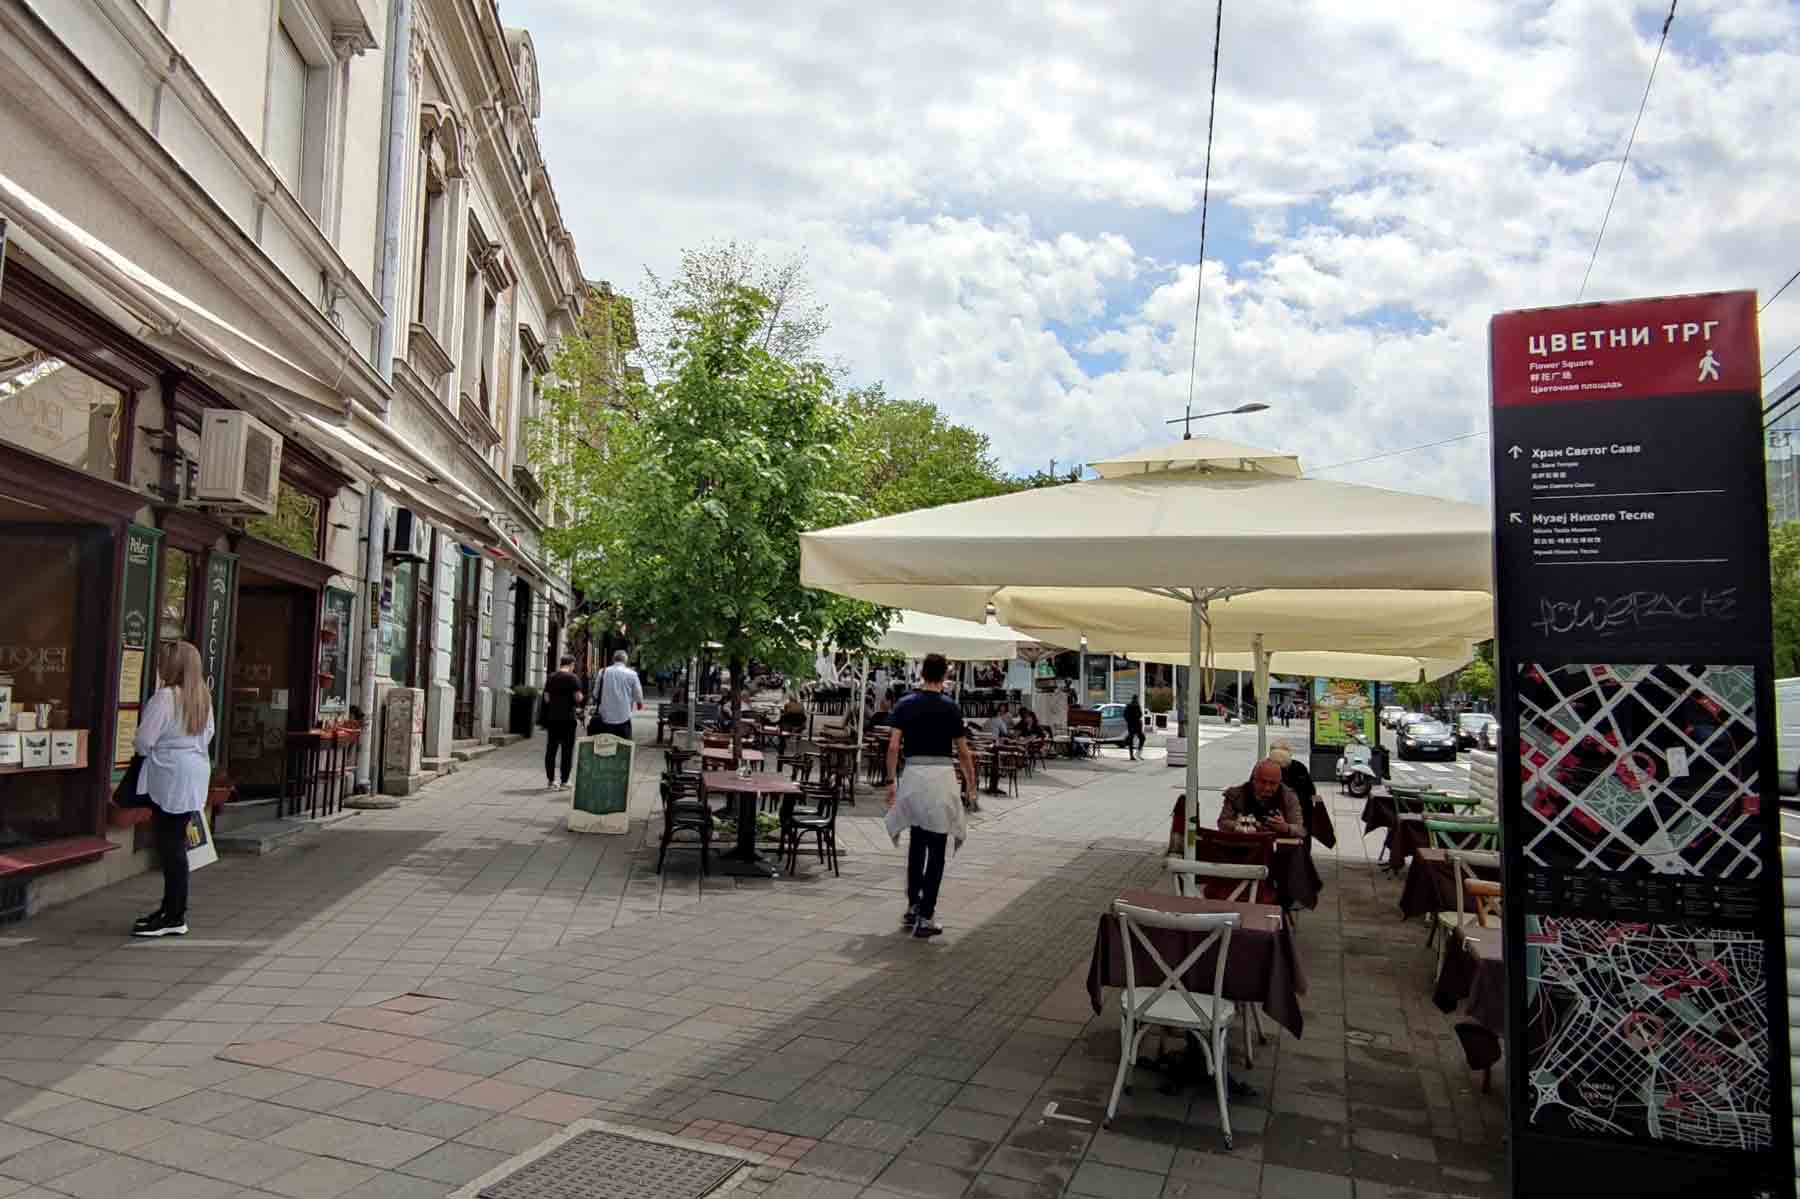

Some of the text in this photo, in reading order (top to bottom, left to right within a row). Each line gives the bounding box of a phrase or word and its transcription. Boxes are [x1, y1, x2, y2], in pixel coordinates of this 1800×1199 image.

[1528, 321, 1719, 356] ЦВЕТНИ ТРГ
[1529, 359, 1594, 371] Flower Square
[1531, 444, 1641, 460] Храм Светог Саве
[1532, 510, 1655, 525] Музеј Николе Тесле
